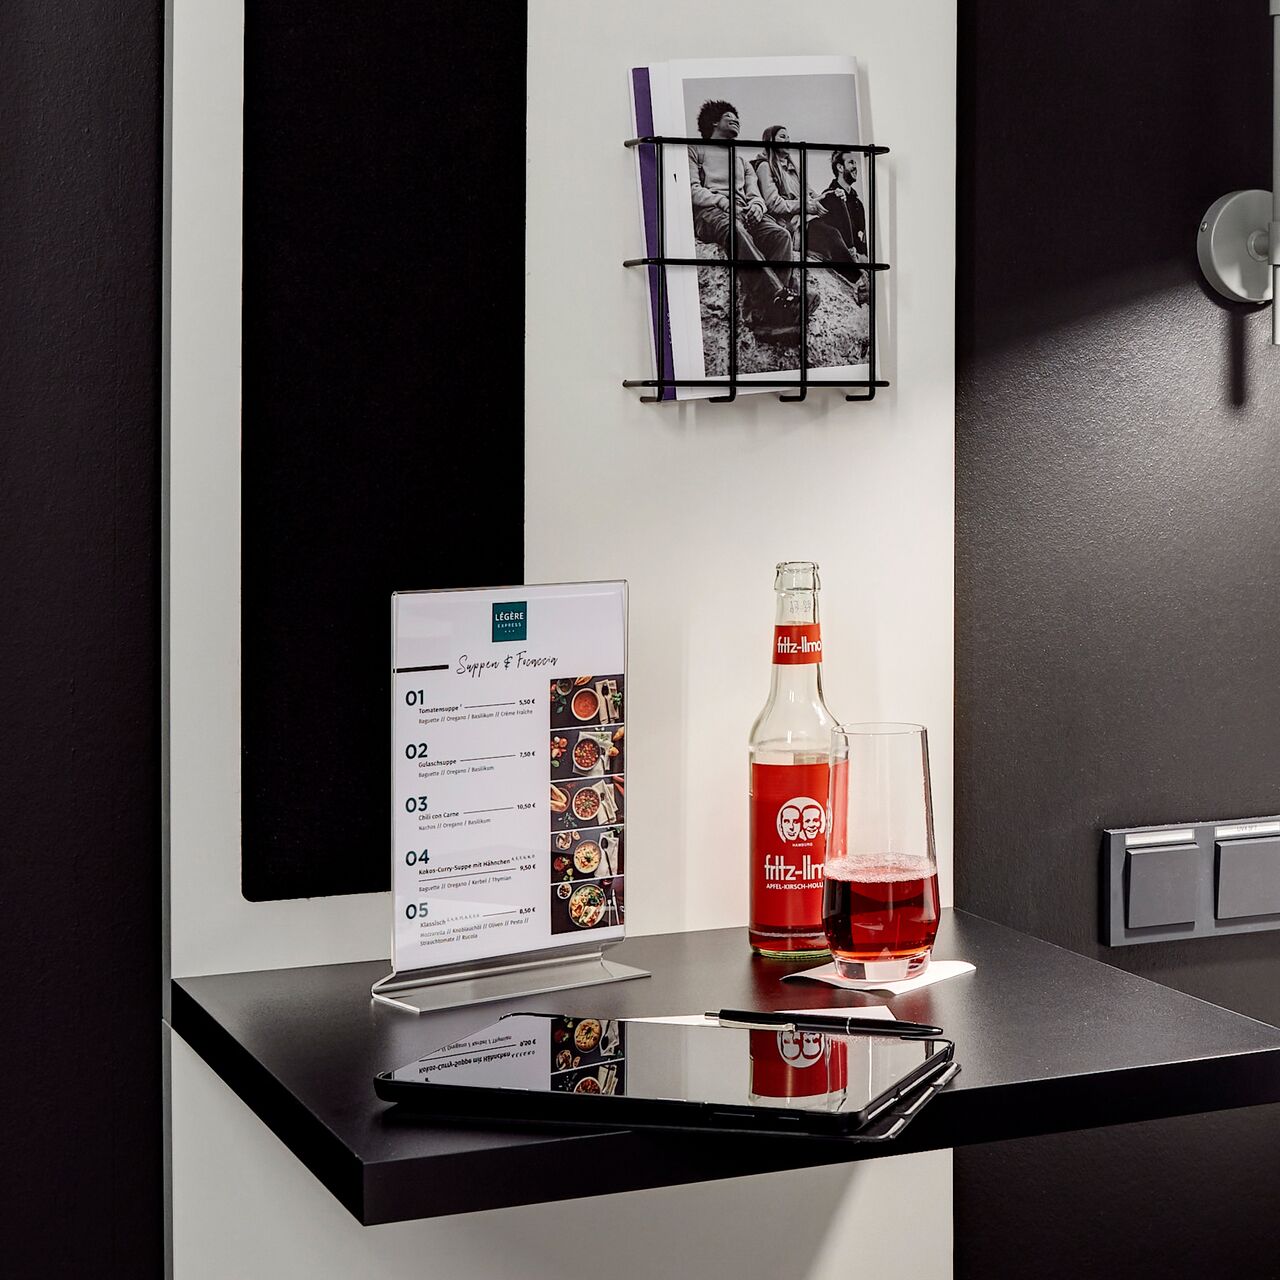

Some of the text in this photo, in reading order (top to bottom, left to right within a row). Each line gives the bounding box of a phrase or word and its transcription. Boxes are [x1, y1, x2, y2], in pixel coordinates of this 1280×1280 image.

[495, 611, 524, 621] LÉGÈRE
[456, 654, 500, 678] Suppen
[516, 650, 559, 669] Focaccia
[405, 689, 424, 706] 01
[419, 705, 459, 714] Tomatensuppe
[418, 716, 439, 725] Baguette
[446, 714, 466, 723] Oregano
[405, 742, 428, 759] 02
[418, 758, 457, 768] Gulaschsuppe
[446, 768, 466, 776] Oregano
[405, 796, 428, 813] 03
[418, 813, 431, 821] Chili
[405, 849, 430, 866] 04
[418, 864, 472, 875] Kokos-Curry-Suppe
[483, 858, 511, 867] Hähnchen
[764, 854, 825, 881] fritz-lim
[766, 881, 824, 890] APFEL-KIRSCH-HOLU
[405, 902, 429, 920] 05
[420, 919, 446, 928] Klassisch
